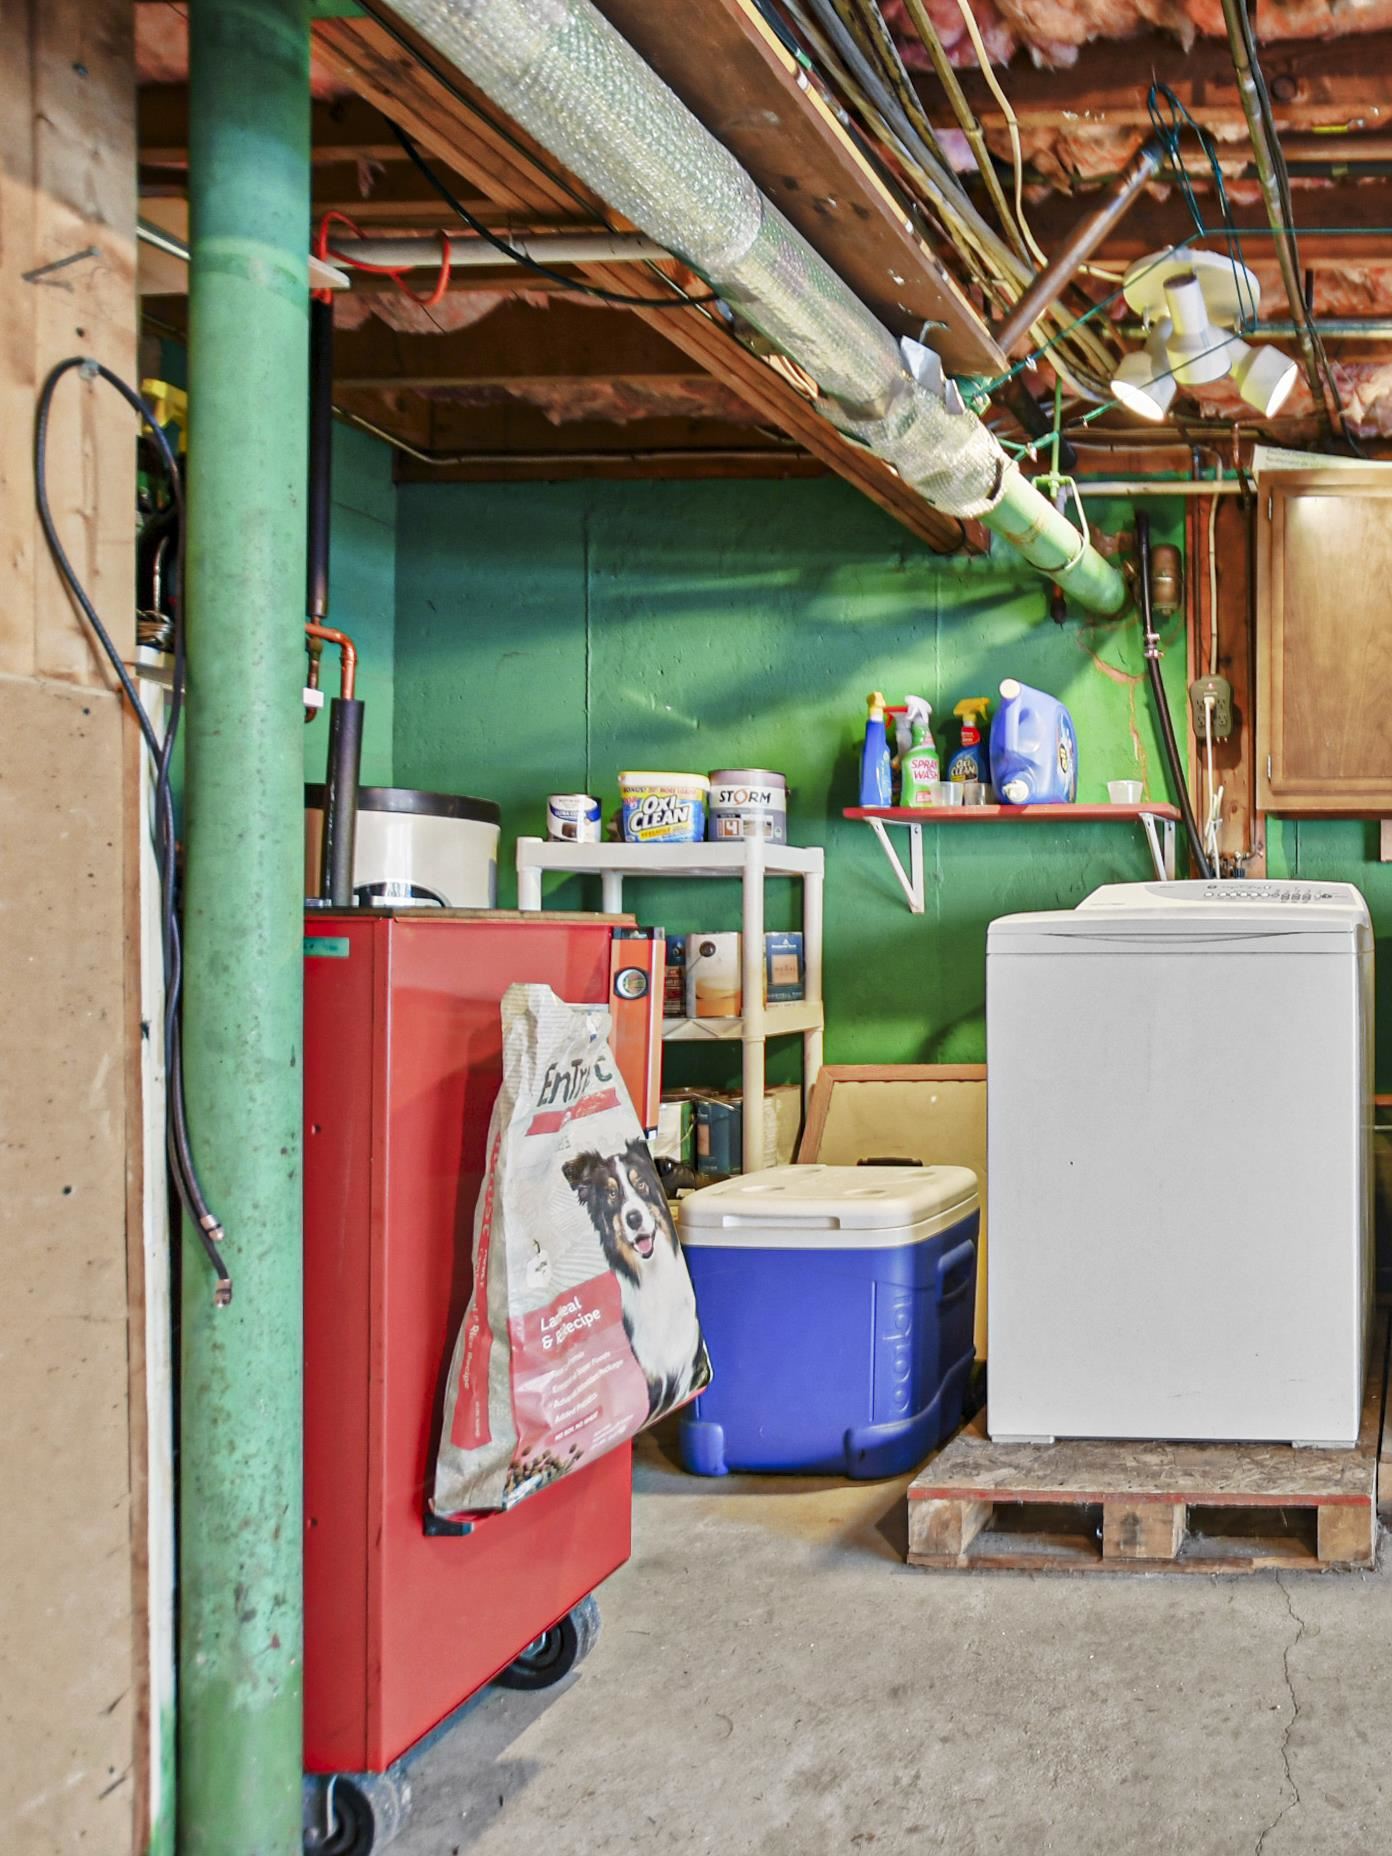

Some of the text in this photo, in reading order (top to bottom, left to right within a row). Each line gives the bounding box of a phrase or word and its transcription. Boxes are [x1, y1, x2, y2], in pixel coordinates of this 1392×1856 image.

[641, 795, 677, 815] OXI
[719, 788, 771, 805] STORM
[630, 806, 689, 832] CLEAN
